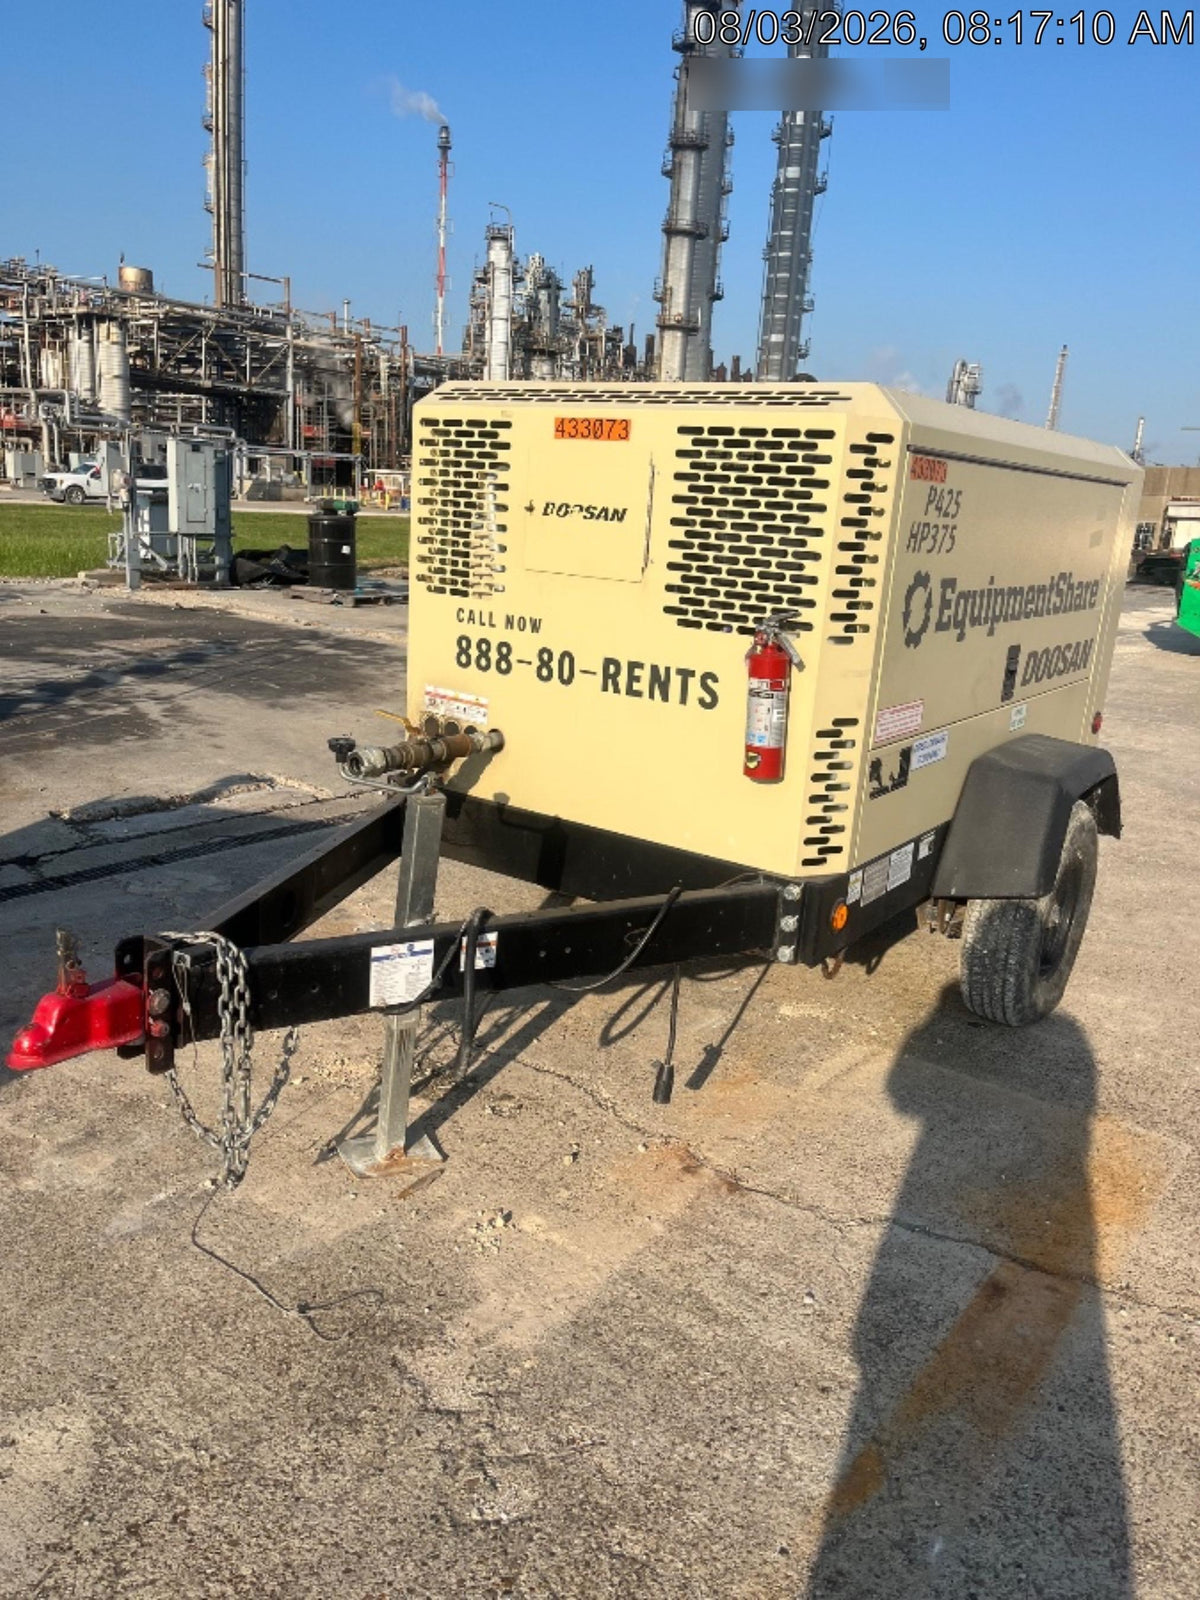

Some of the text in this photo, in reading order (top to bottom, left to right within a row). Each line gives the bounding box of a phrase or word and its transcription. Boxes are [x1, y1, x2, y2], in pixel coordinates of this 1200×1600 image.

[555, 418, 629, 440] 433073
[924, 485, 963, 519] P425
[906, 521, 957, 554] HP375
[456, 607, 542, 634] CALL NOW
[935, 571, 1100, 642] EquipmentShare
[455, 634, 720, 710] 888-80-RENTS
[1020, 638, 1094, 687] DOOSAN
